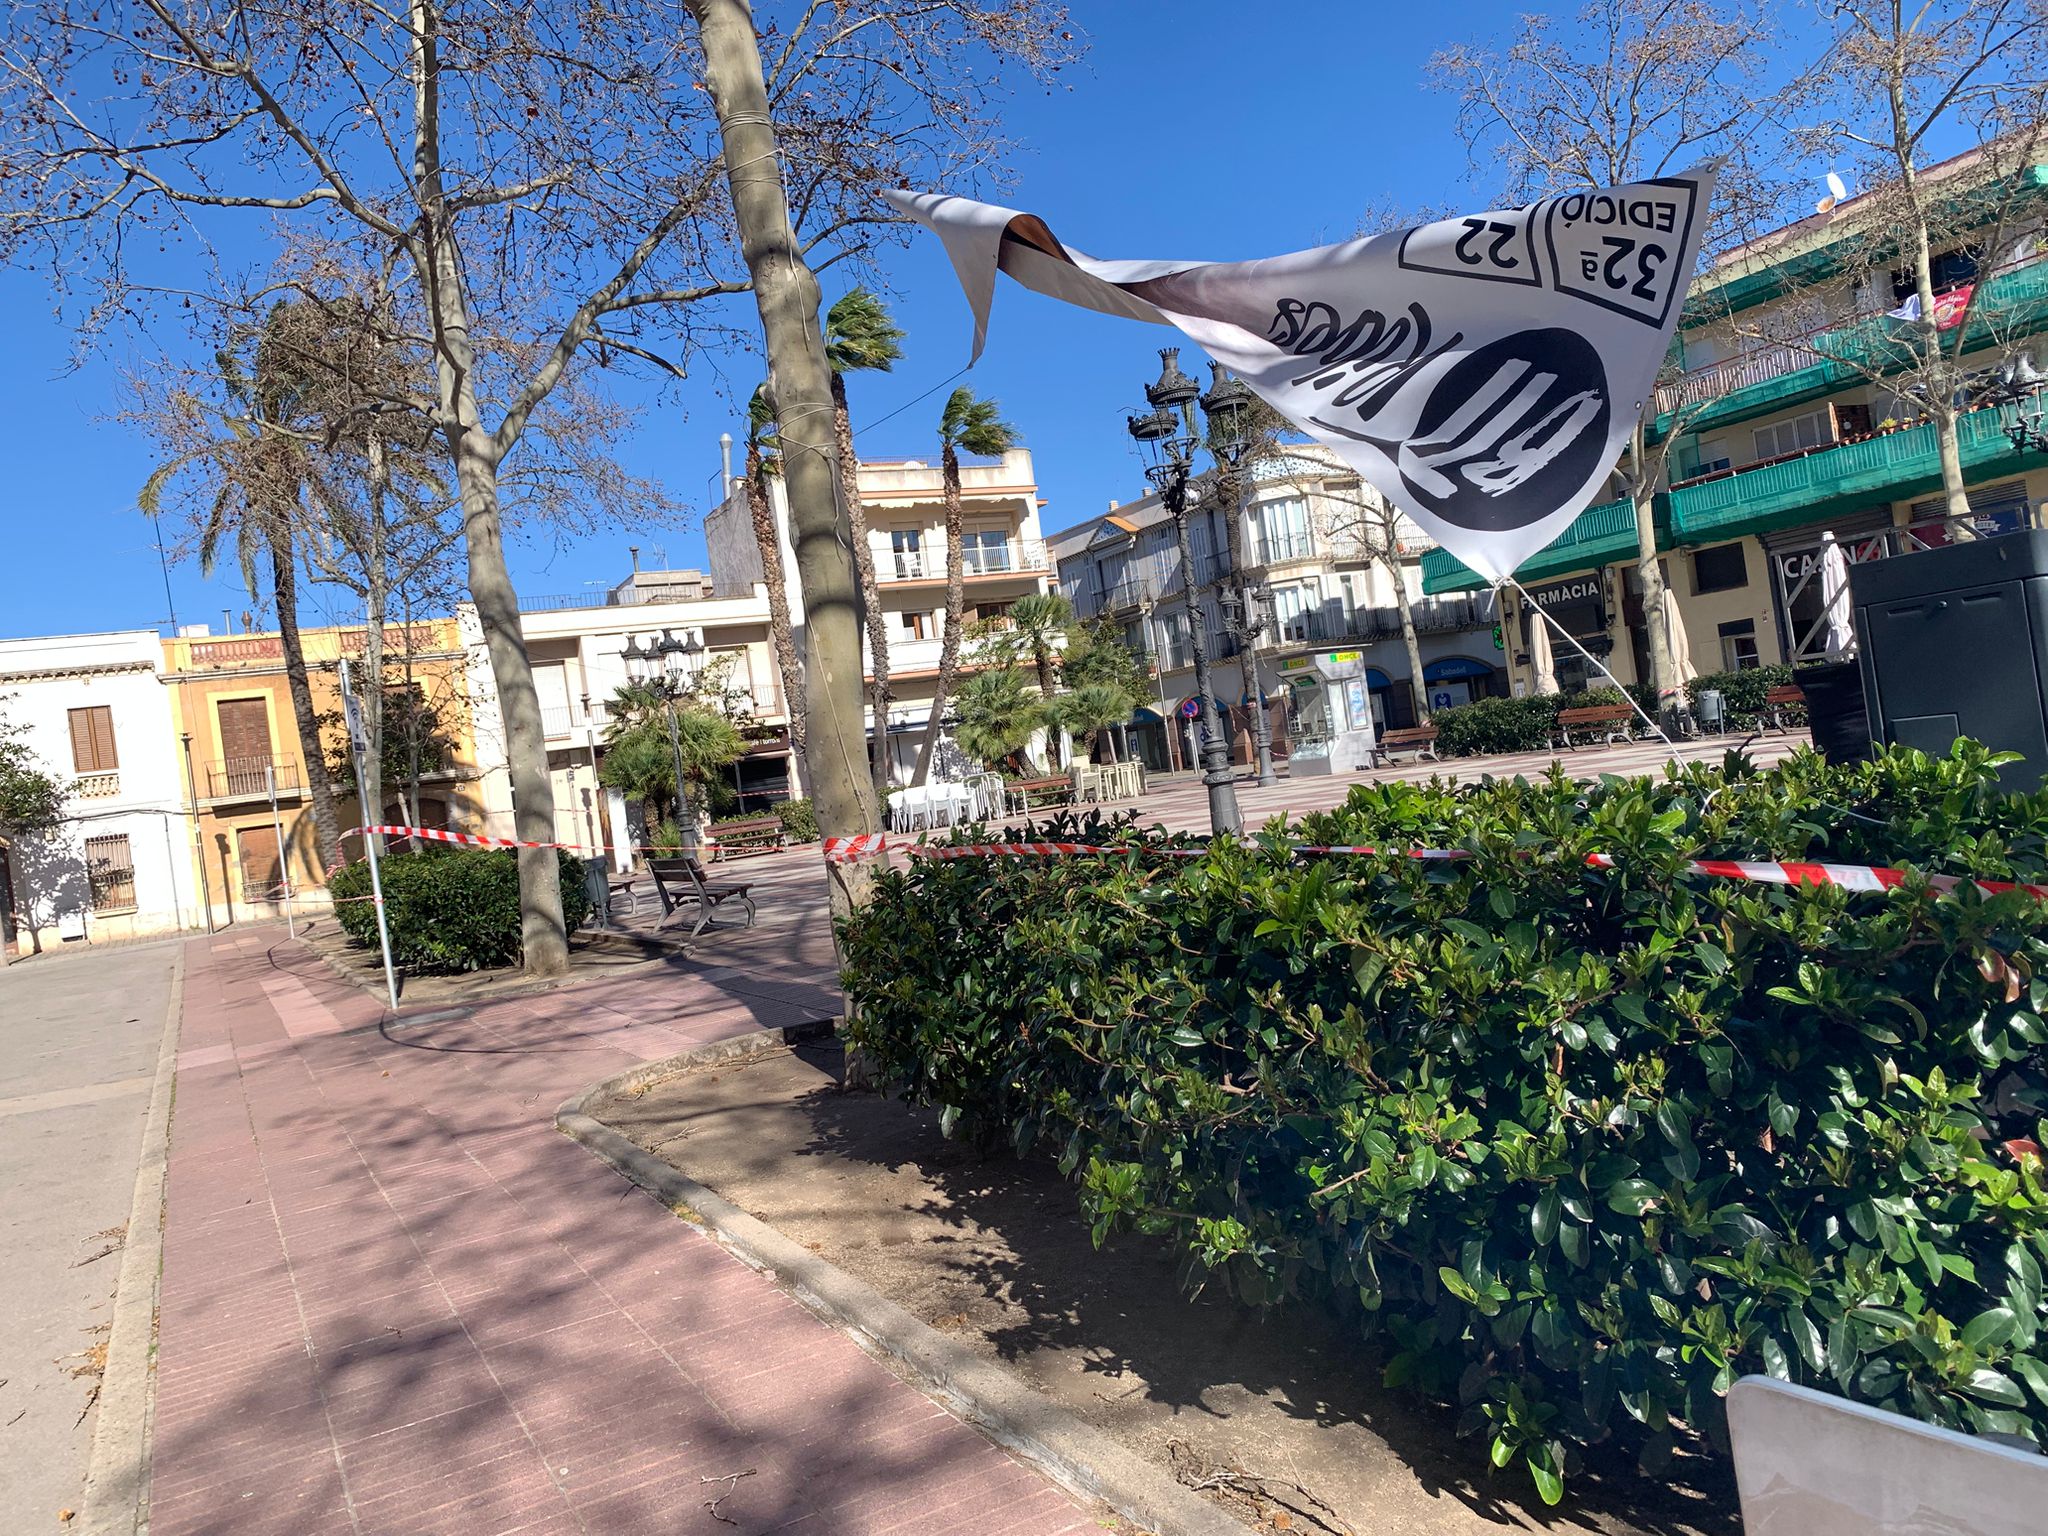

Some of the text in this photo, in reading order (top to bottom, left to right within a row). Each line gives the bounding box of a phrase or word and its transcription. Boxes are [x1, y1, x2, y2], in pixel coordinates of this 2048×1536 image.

[1561, 194, 1676, 233] EDICIÓ
[1455, 217, 1519, 269] 22
[1520, 582, 1599, 610] FARMÀCIA
